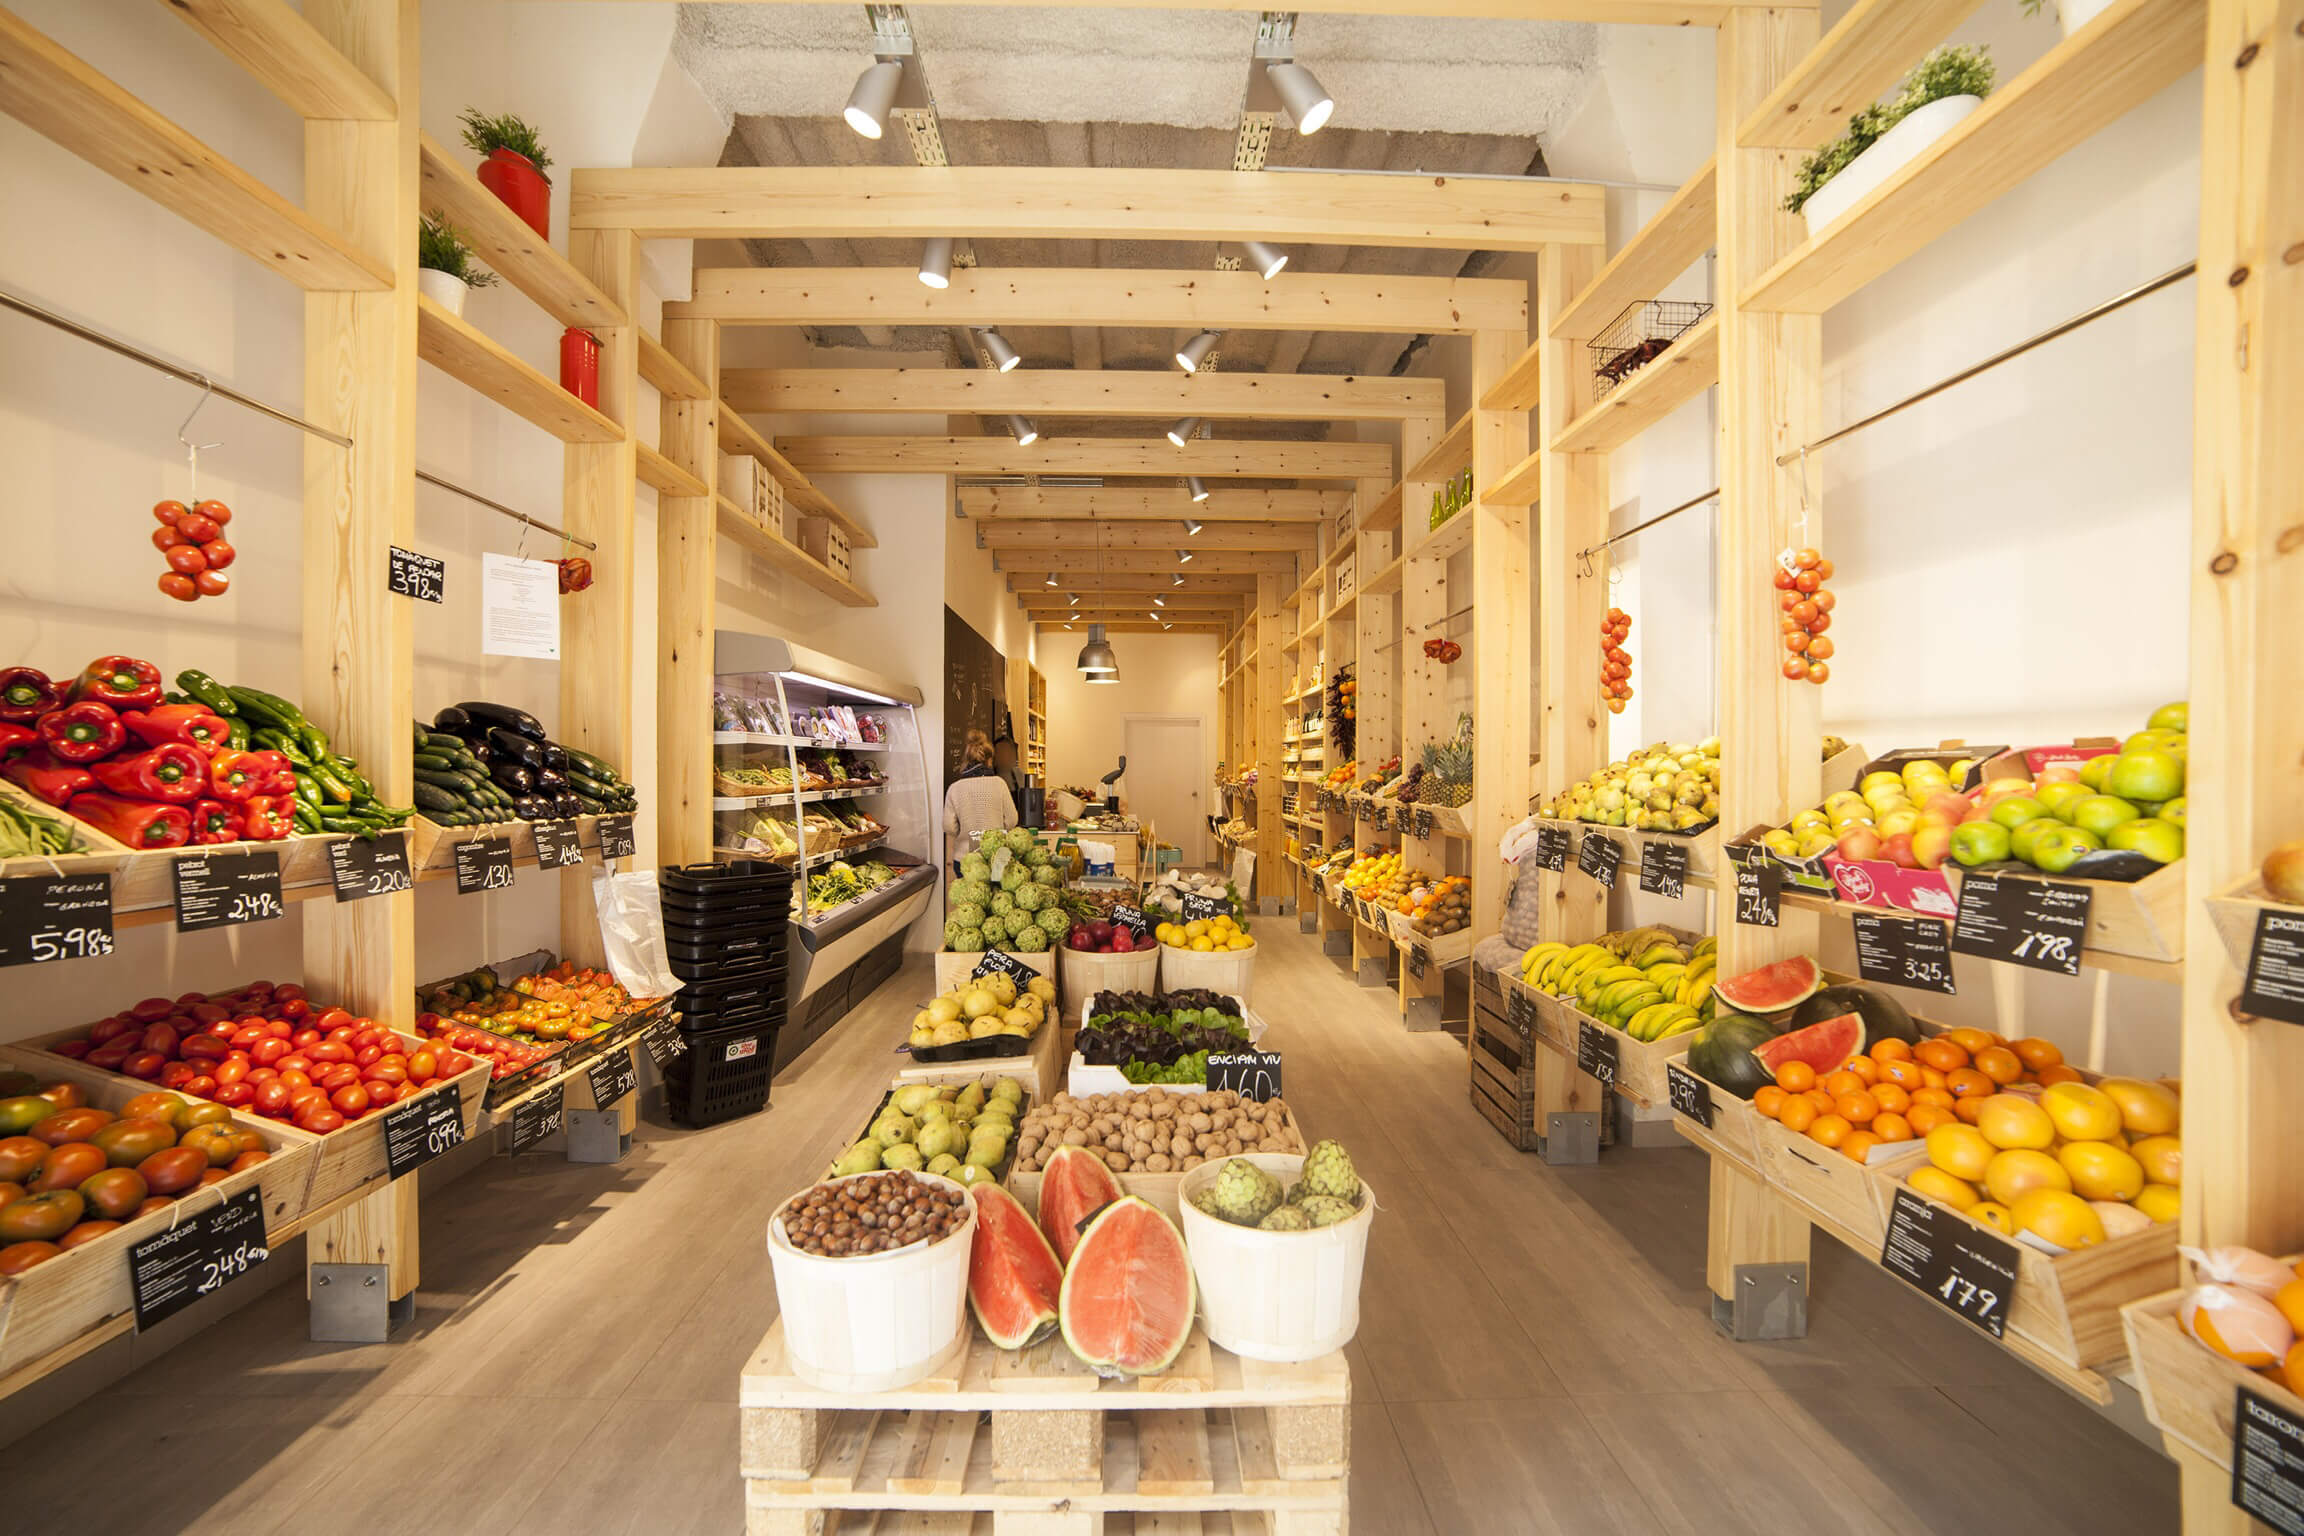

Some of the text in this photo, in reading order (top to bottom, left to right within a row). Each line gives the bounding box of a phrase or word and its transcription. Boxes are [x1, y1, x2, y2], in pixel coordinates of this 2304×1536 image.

[1965, 880, 1998, 891] poma
[988, 949, 1013, 968] PERA
[1207, 1054, 1257, 1065] ENCIAM
[135, 1220, 198, 1258] tomàquet
